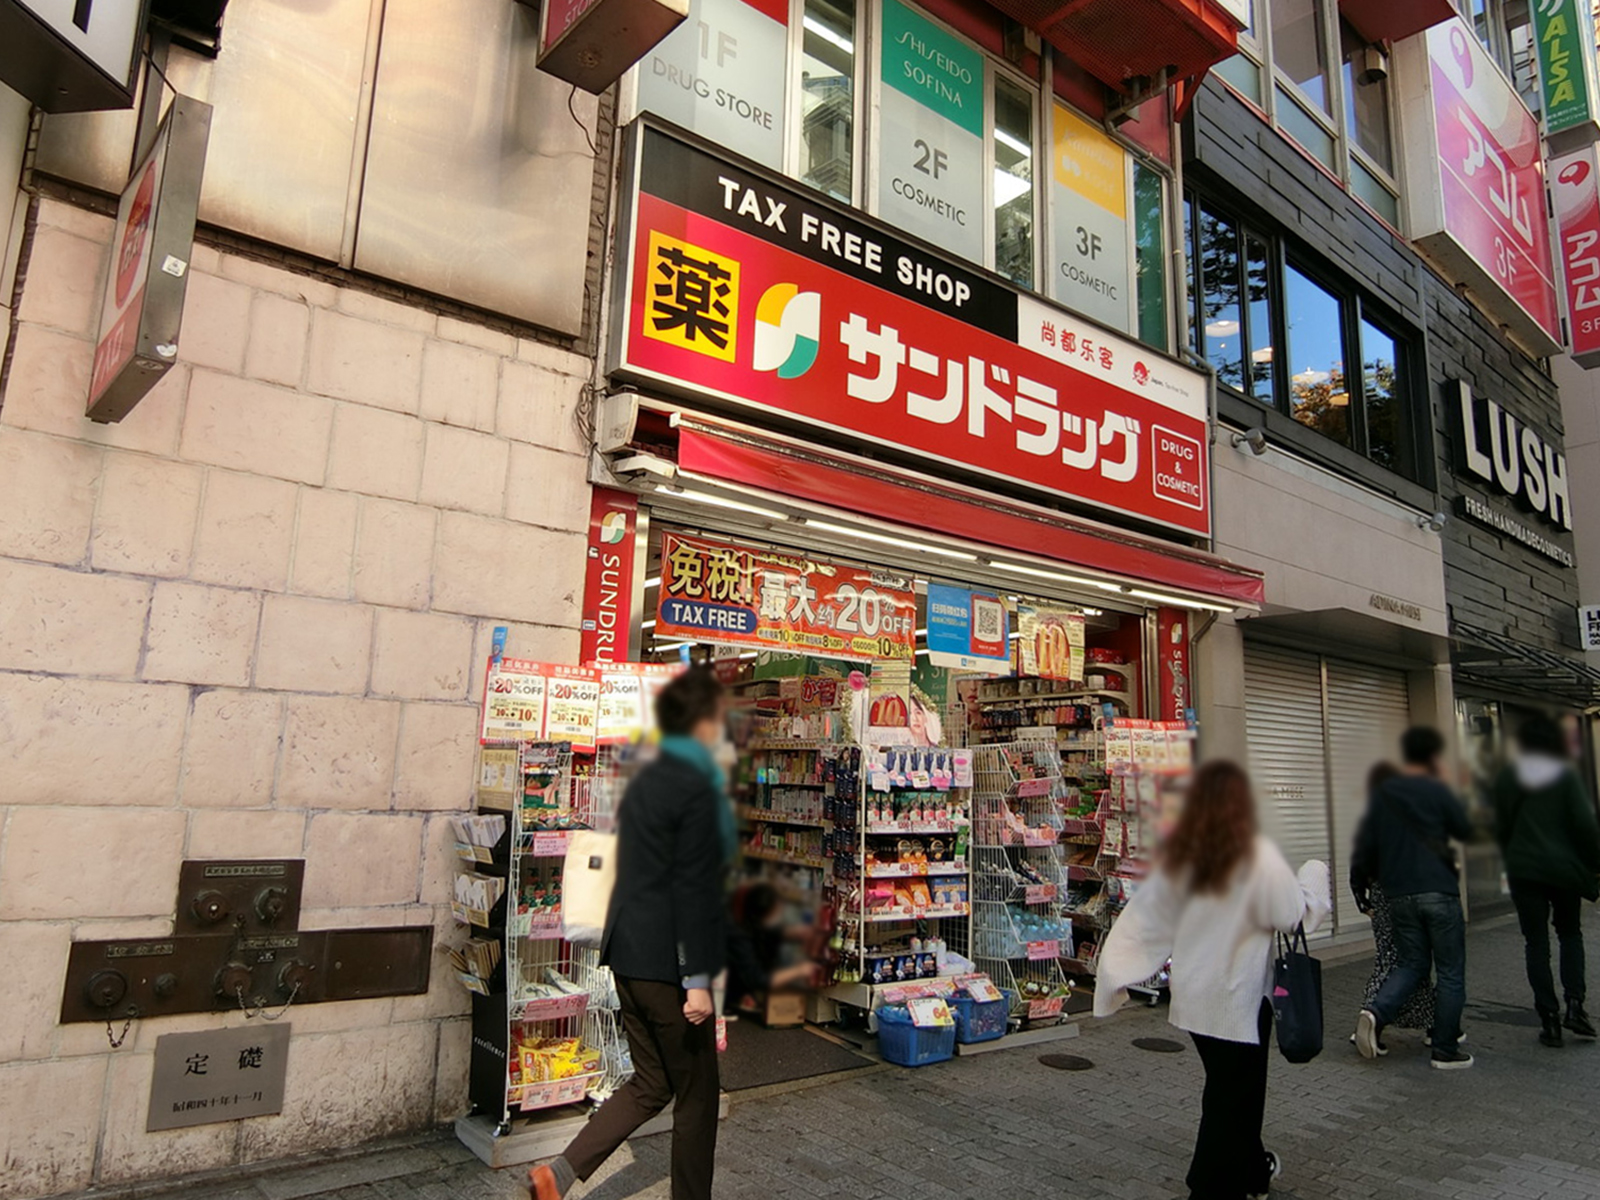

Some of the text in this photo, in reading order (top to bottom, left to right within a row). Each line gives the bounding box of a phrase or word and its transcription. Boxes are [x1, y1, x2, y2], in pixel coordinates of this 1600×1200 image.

[697, 20, 738, 68] 1F
[895, 31, 972, 85] SHISEIDO
[652, 56, 773, 131] DRUG STORE
[903, 60, 963, 108] SOFINA
[913, 138, 948, 180] 2F
[1457, 105, 1534, 247] アコム
[892, 178, 966, 226] COSMETIC
[718, 176, 971, 307] TAX FREE SHOP
[1076, 226, 1102, 260] 3F
[1495, 235, 1517, 286] 3F
[1060, 262, 1118, 301] COSMETIC
[1567, 230, 1600, 311] アコム
[652, 246, 731, 350] 薬
[1041, 320, 1113, 371] 尚都乐客
[839, 312, 1142, 483] サンドラッグ
[1161, 438, 1194, 460] DRUG
[1174, 461, 1183, 475] &
[1460, 379, 1572, 532] LUSH
[1157, 472, 1199, 497] COSMETIC
[1465, 496, 1494, 526] FRESH
[672, 603, 747, 630] TAX FREE
